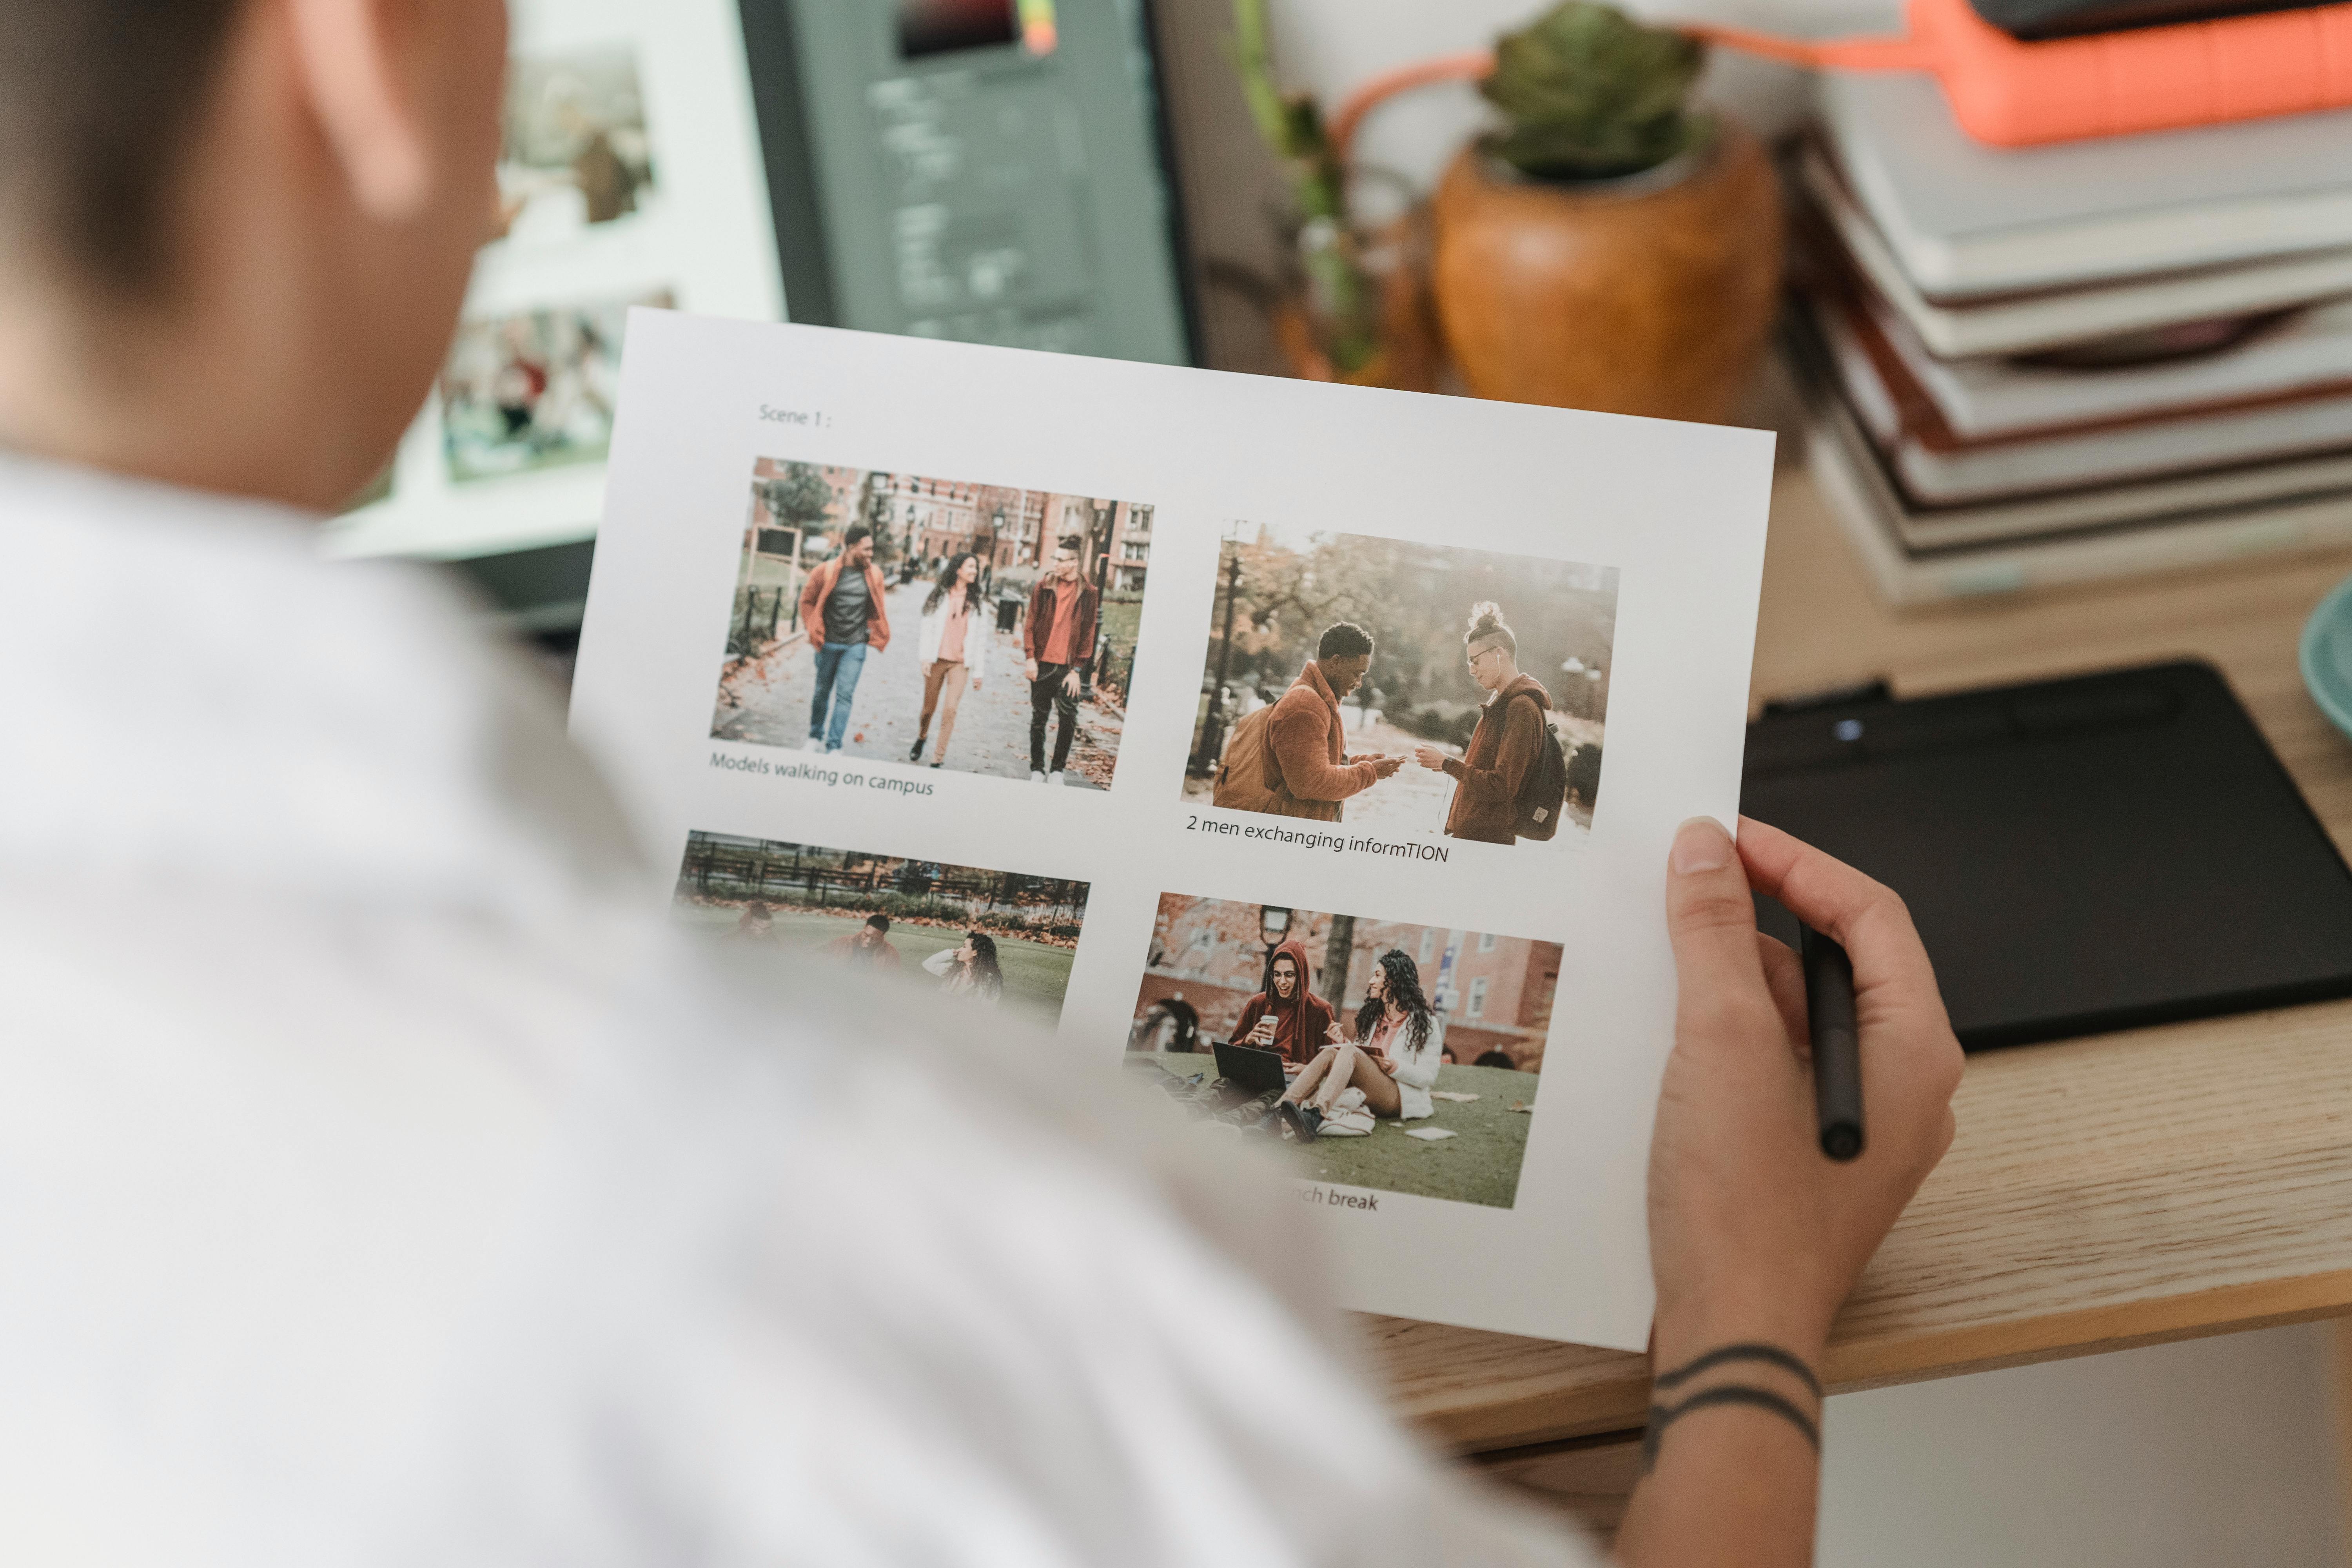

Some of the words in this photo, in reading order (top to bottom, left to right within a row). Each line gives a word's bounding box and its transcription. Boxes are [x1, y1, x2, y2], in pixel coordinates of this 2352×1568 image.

[759, 404, 808, 425] Scene
[710, 753, 769, 774] Models
[775, 764, 838, 786] walking
[842, 773, 864, 786] on
[868, 776, 934, 796] campus
[1186, 815, 1197, 830] 2
[1201, 820, 1240, 836] men
[1244, 826, 1345, 853] exchanging
[1349, 835, 1449, 863] informTION
[1328, 1189, 1379, 1211] break
